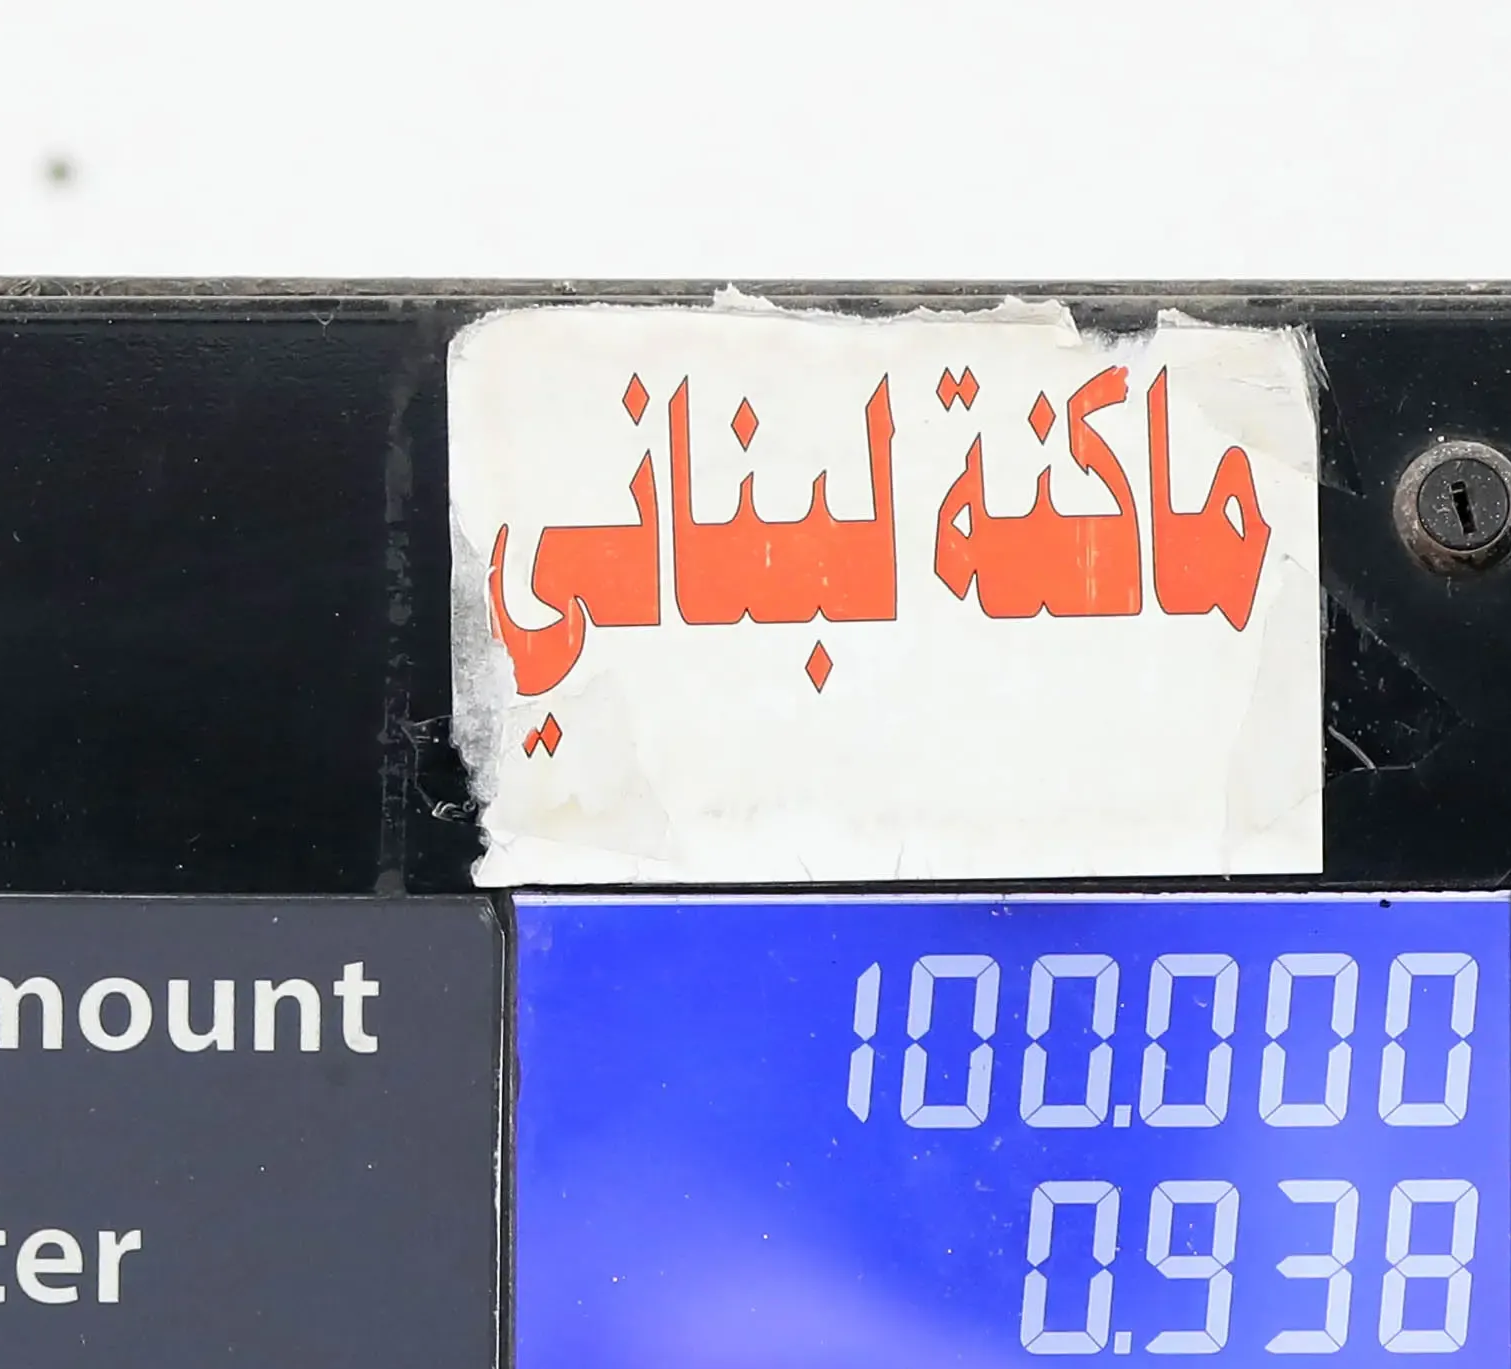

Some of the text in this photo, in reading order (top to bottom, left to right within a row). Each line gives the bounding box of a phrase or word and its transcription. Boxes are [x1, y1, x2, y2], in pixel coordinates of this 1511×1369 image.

[489, 366, 1271, 758] ماكنة لبناني
[847, 952, 1479, 1128] 100.000
[1019, 1179, 1479, 1354] 0.938
